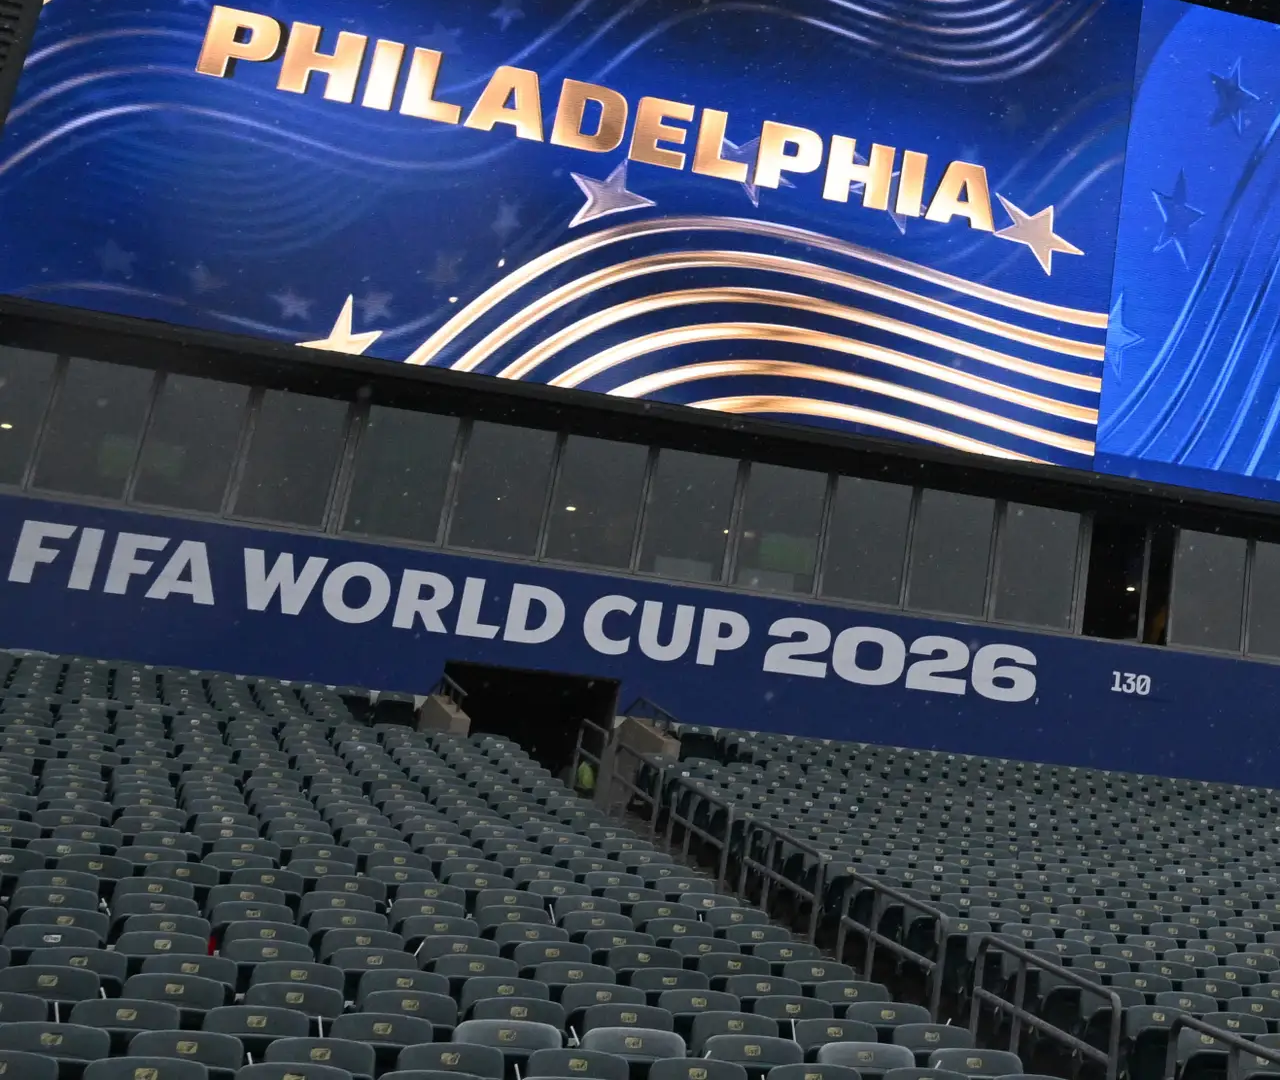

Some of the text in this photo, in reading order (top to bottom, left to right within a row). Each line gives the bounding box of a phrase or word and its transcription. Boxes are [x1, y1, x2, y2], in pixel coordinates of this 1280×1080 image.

[194, 4, 996, 233] PHILADELPHIA
[7, 519, 1038, 702] FIFA WORLD CUP 2026
[1110, 670, 1151, 696] 130
